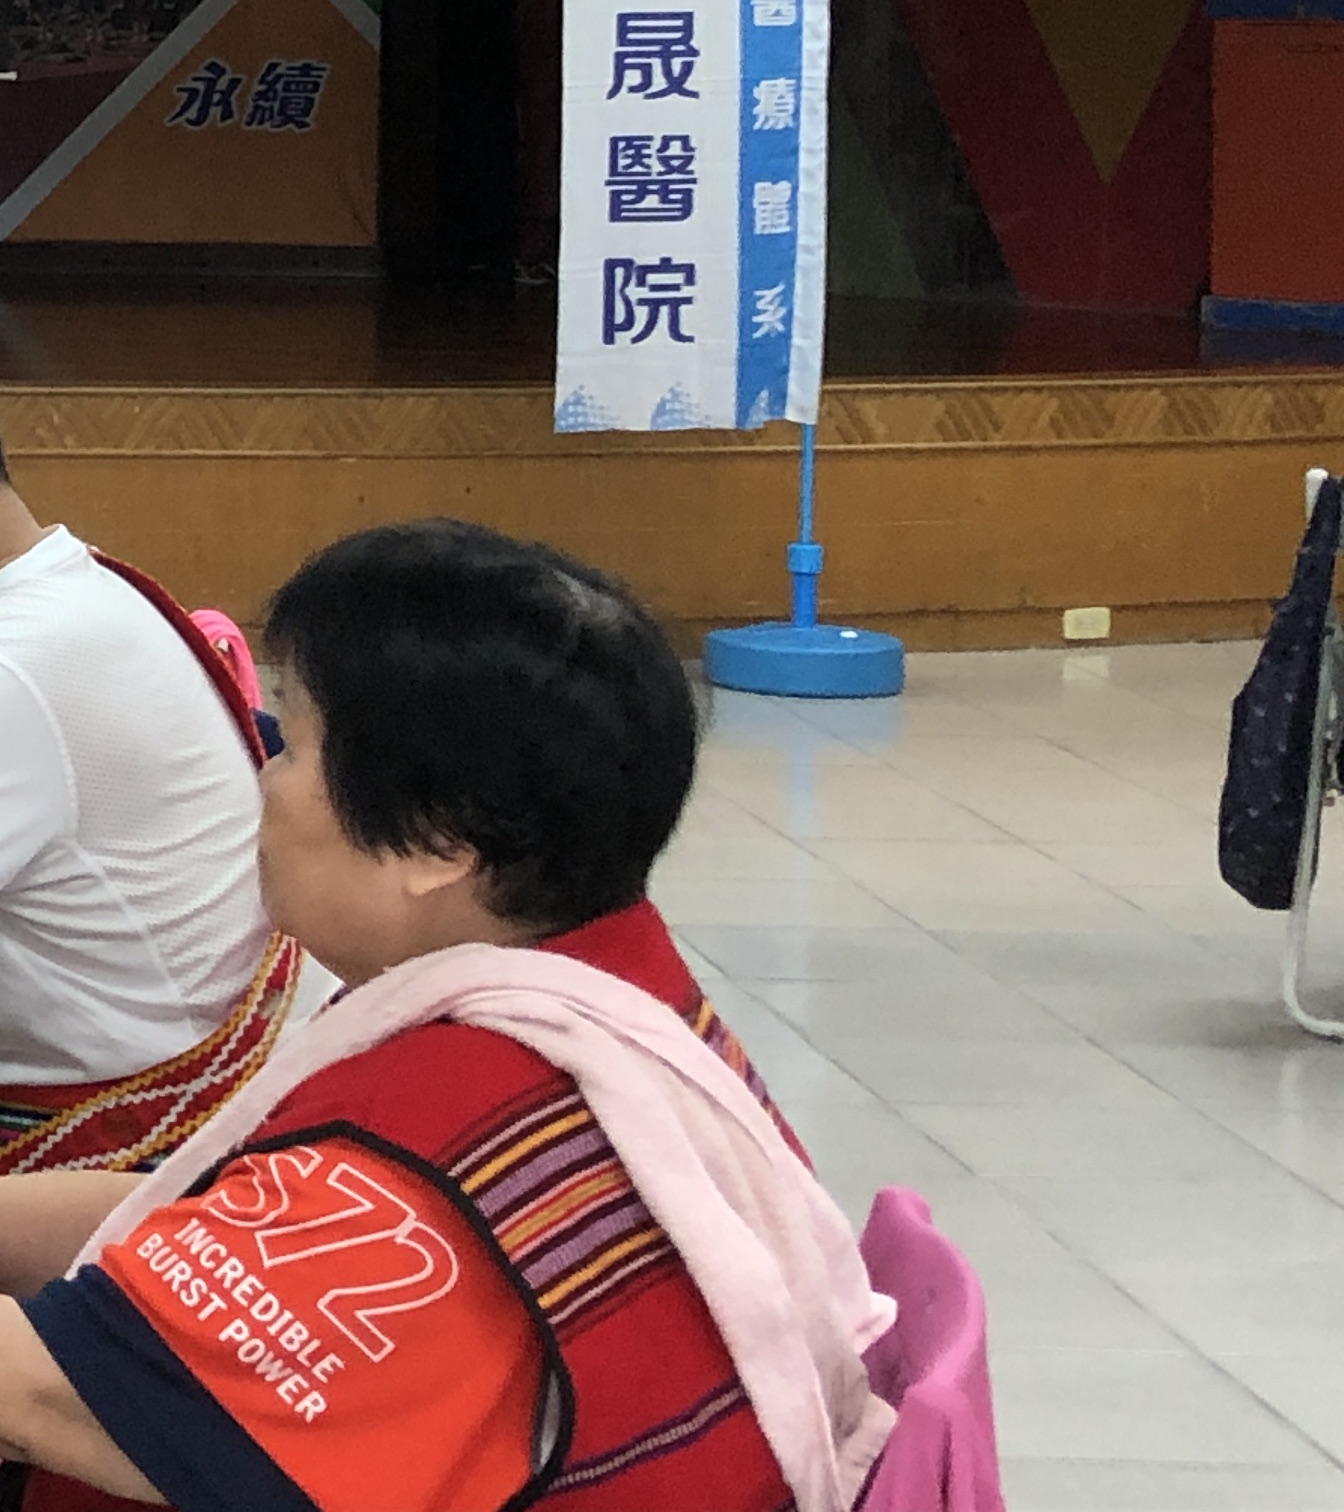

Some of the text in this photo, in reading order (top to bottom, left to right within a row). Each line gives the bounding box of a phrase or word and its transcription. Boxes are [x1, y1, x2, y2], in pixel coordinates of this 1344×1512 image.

[165, 60, 326, 131] 永續
[136, 1231, 329, 1424] BURST POWER
[173, 1217, 346, 1385] INCREDIBLE
